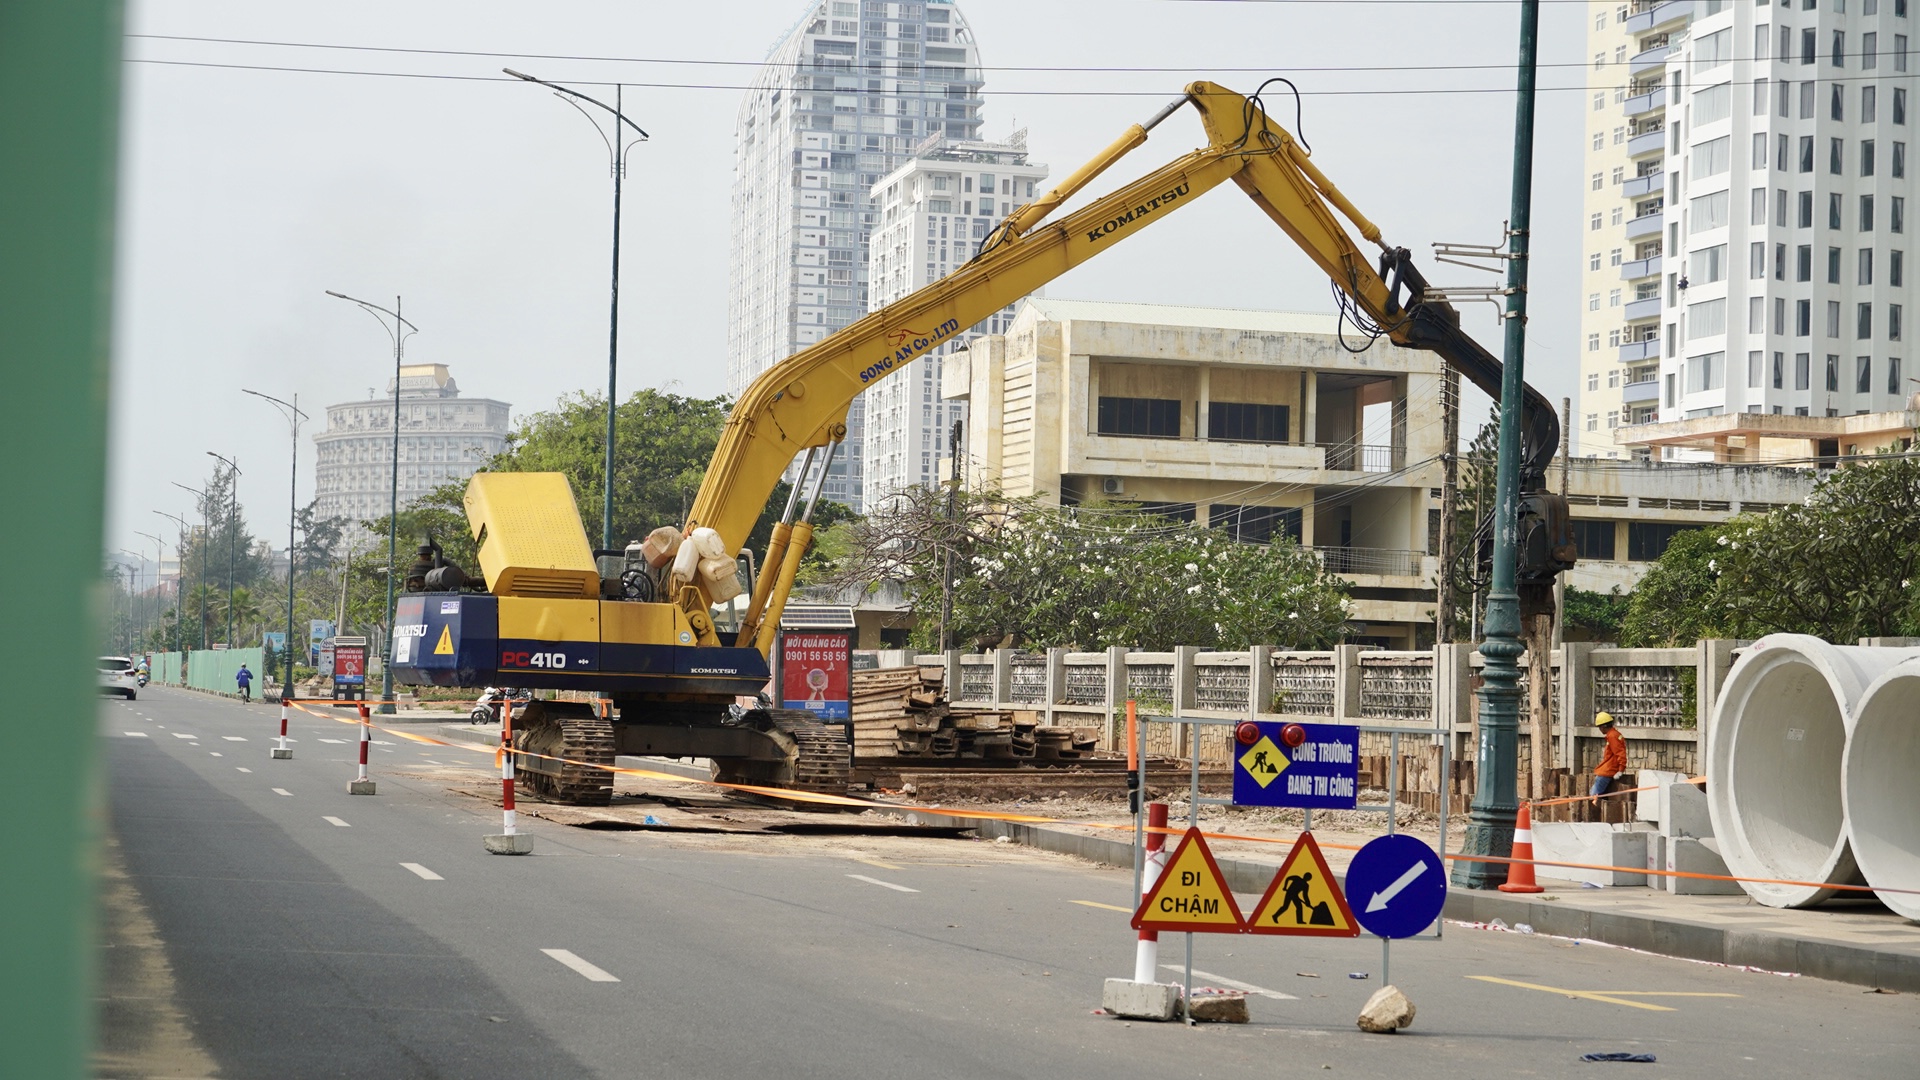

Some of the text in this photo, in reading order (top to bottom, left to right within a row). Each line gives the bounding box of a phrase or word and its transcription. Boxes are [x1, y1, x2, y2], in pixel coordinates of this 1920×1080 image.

[1086, 182, 1190, 243] KOMATSU
[860, 357, 893, 383] SONG
[895, 344, 914, 363] AN
[830, 636, 846, 648] CÁO
[502, 652, 566, 668] PC410
[785, 651, 846, 661] 0901 56 58 56
[1318, 738, 1353, 764] TRƯỜNG
[1287, 772, 1354, 797] ĐANG THI CÔNG
[1181, 871, 1200, 887] ĐI
[1160, 894, 1219, 917] CHẬM
